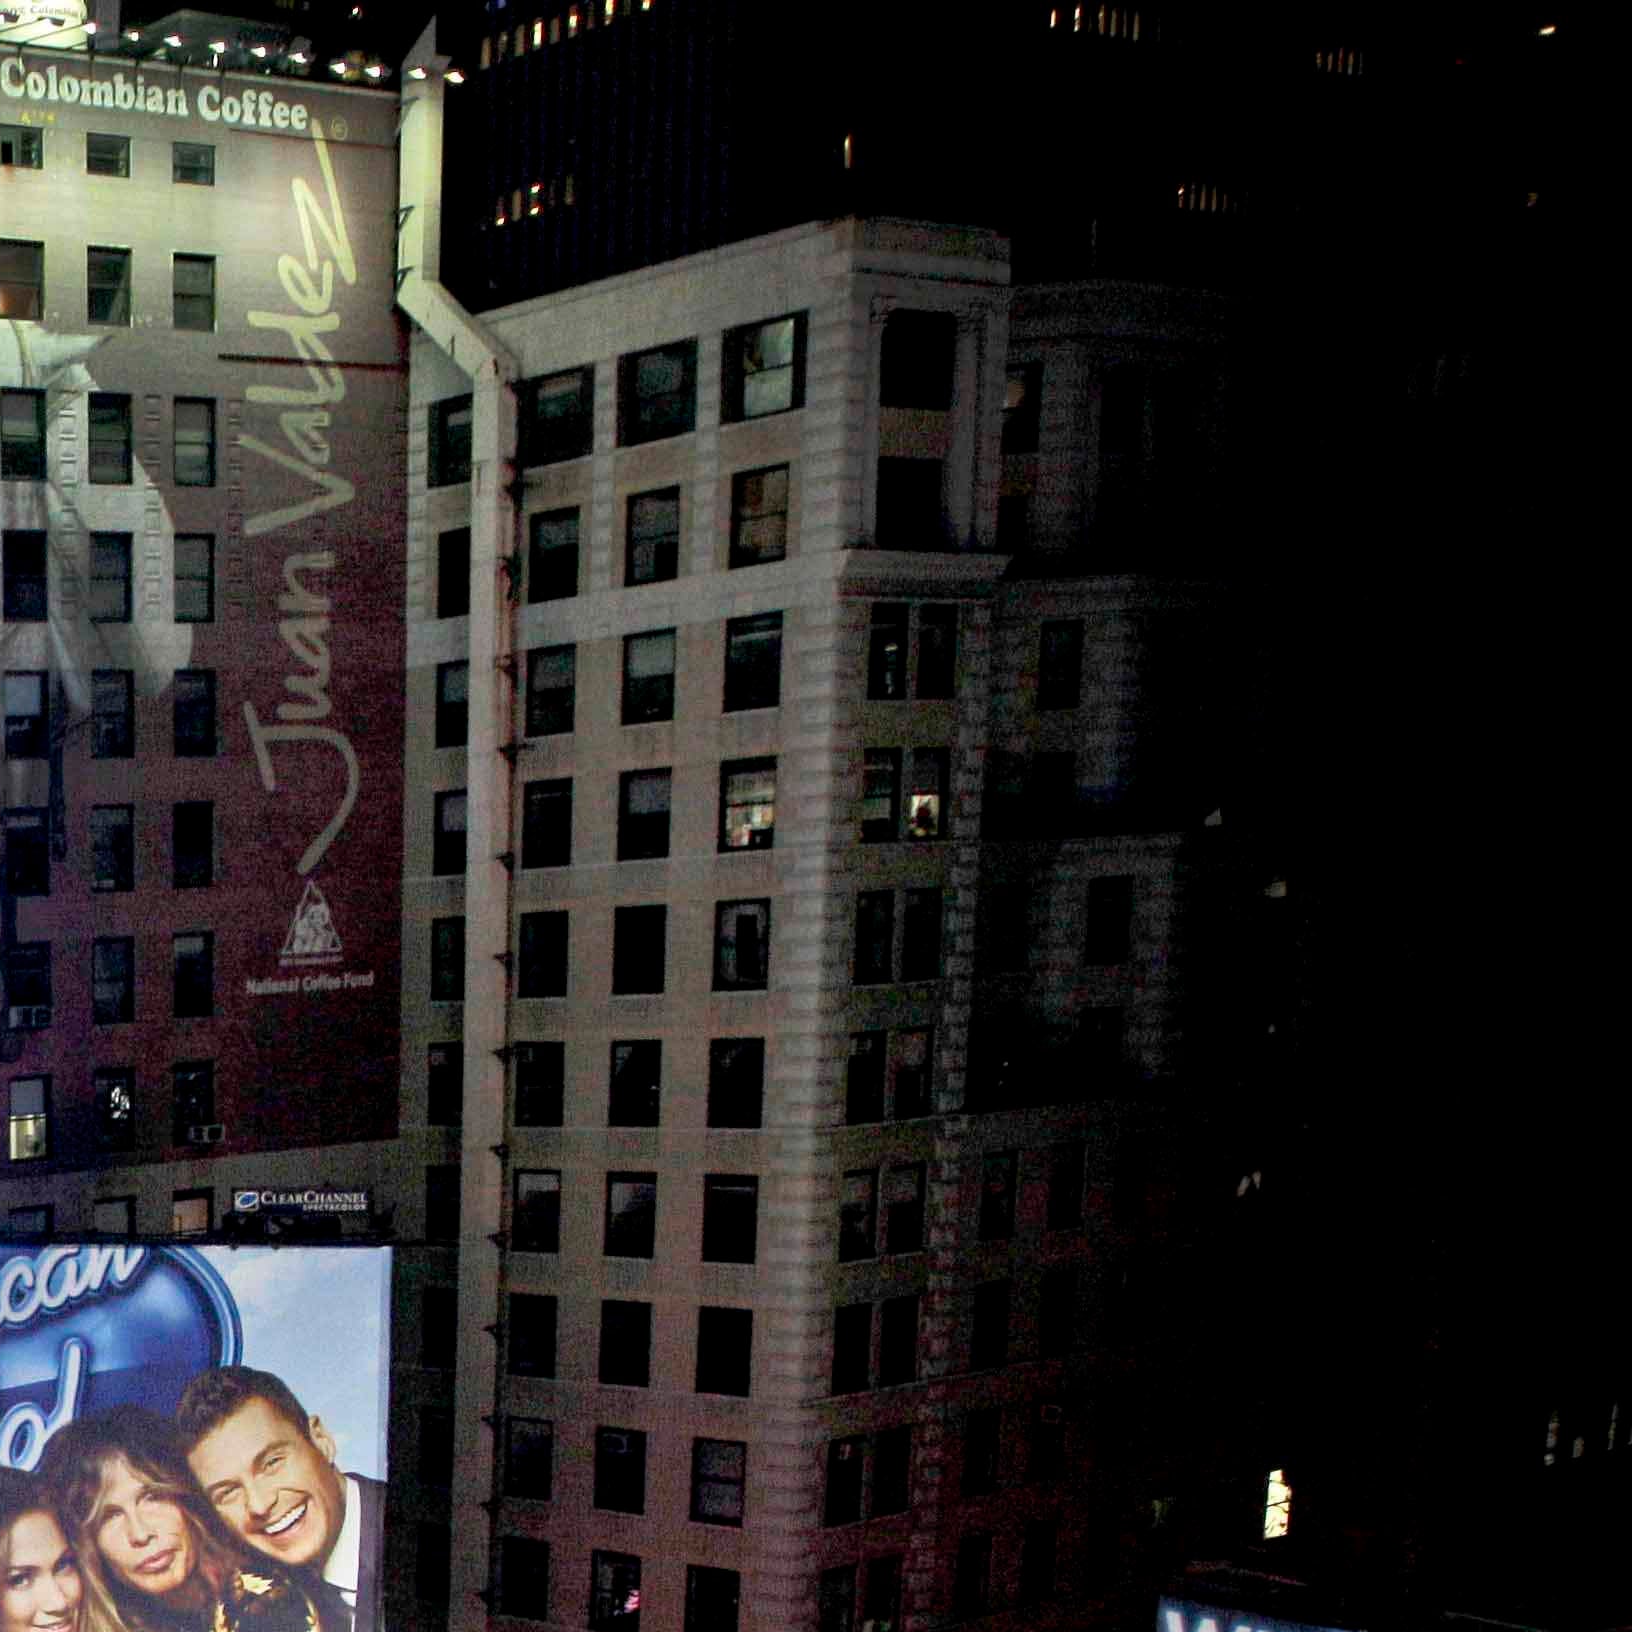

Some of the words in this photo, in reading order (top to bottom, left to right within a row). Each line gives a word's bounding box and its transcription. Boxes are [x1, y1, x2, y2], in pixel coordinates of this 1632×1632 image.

[0, 57, 189, 118] Colombian
[197, 86, 308, 130] Coffee
[244, 548, 359, 876] Juan
